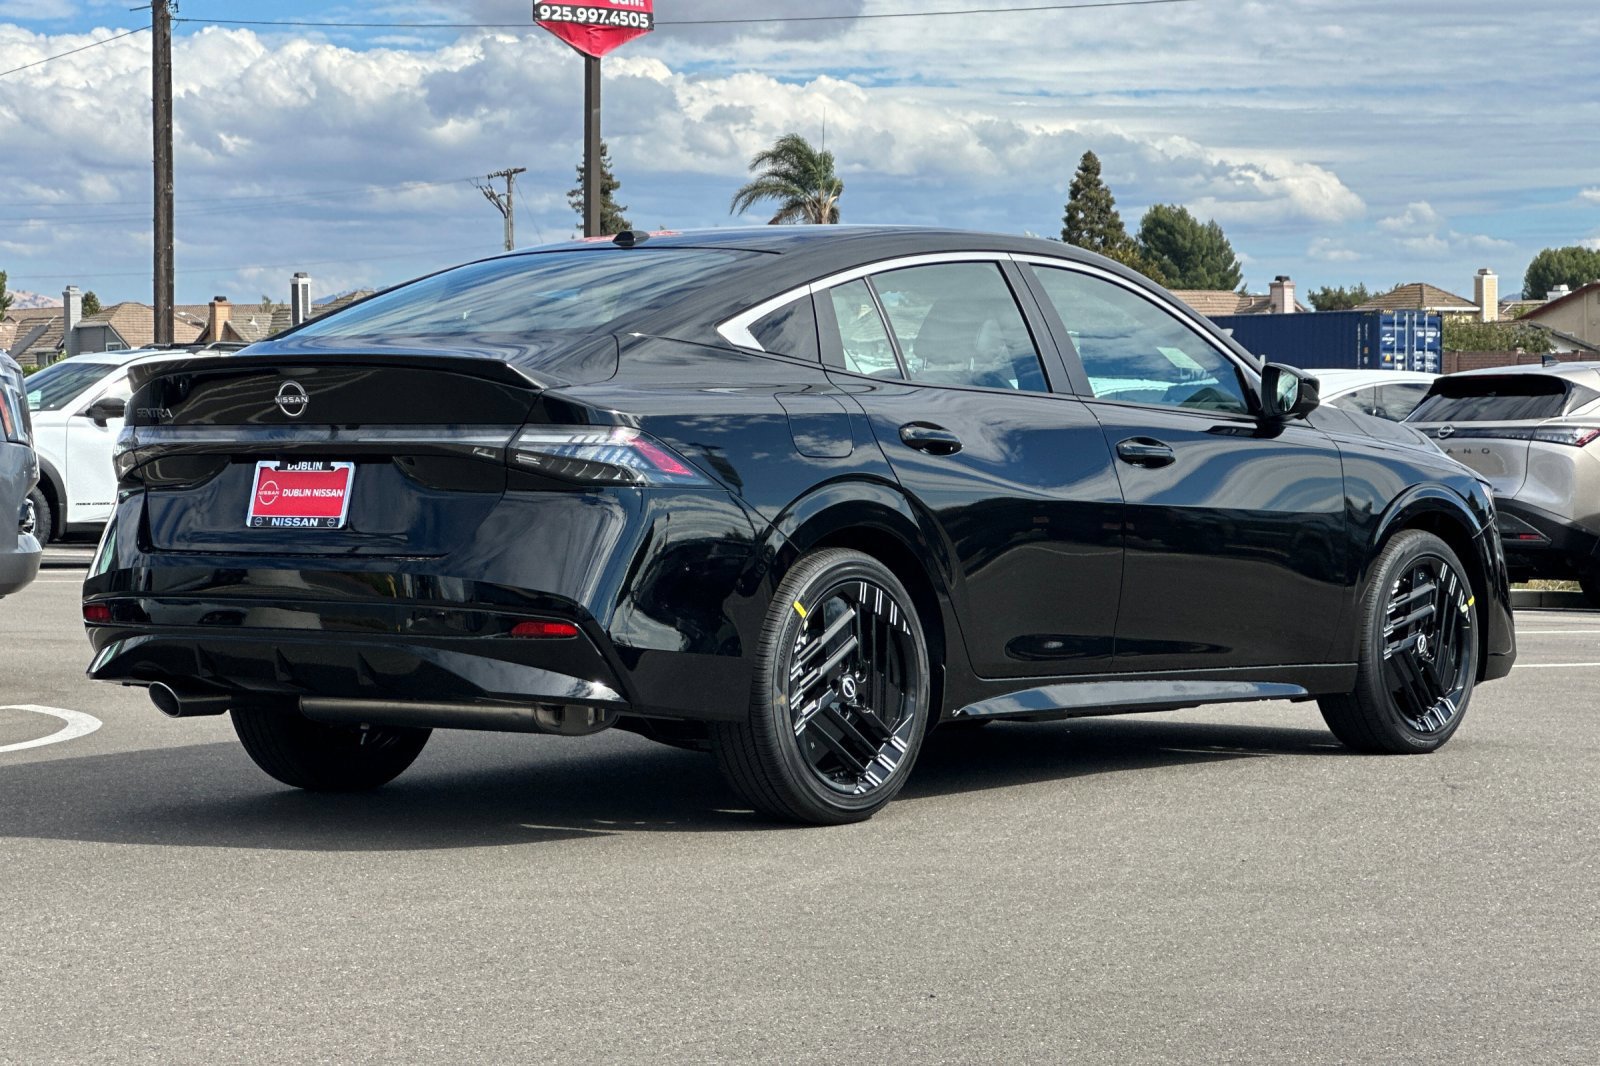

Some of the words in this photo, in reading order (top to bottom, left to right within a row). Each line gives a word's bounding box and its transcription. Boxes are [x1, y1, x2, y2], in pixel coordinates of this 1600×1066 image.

[539, 5, 649, 28] 925.997.4505
[136, 407, 173, 418] SENTRA
[287, 462, 323, 470] DUBLIN
[282, 488, 311, 497] DUBLIN
[312, 488, 343, 497] NISSAN
[271, 517, 319, 527] NISSAN
